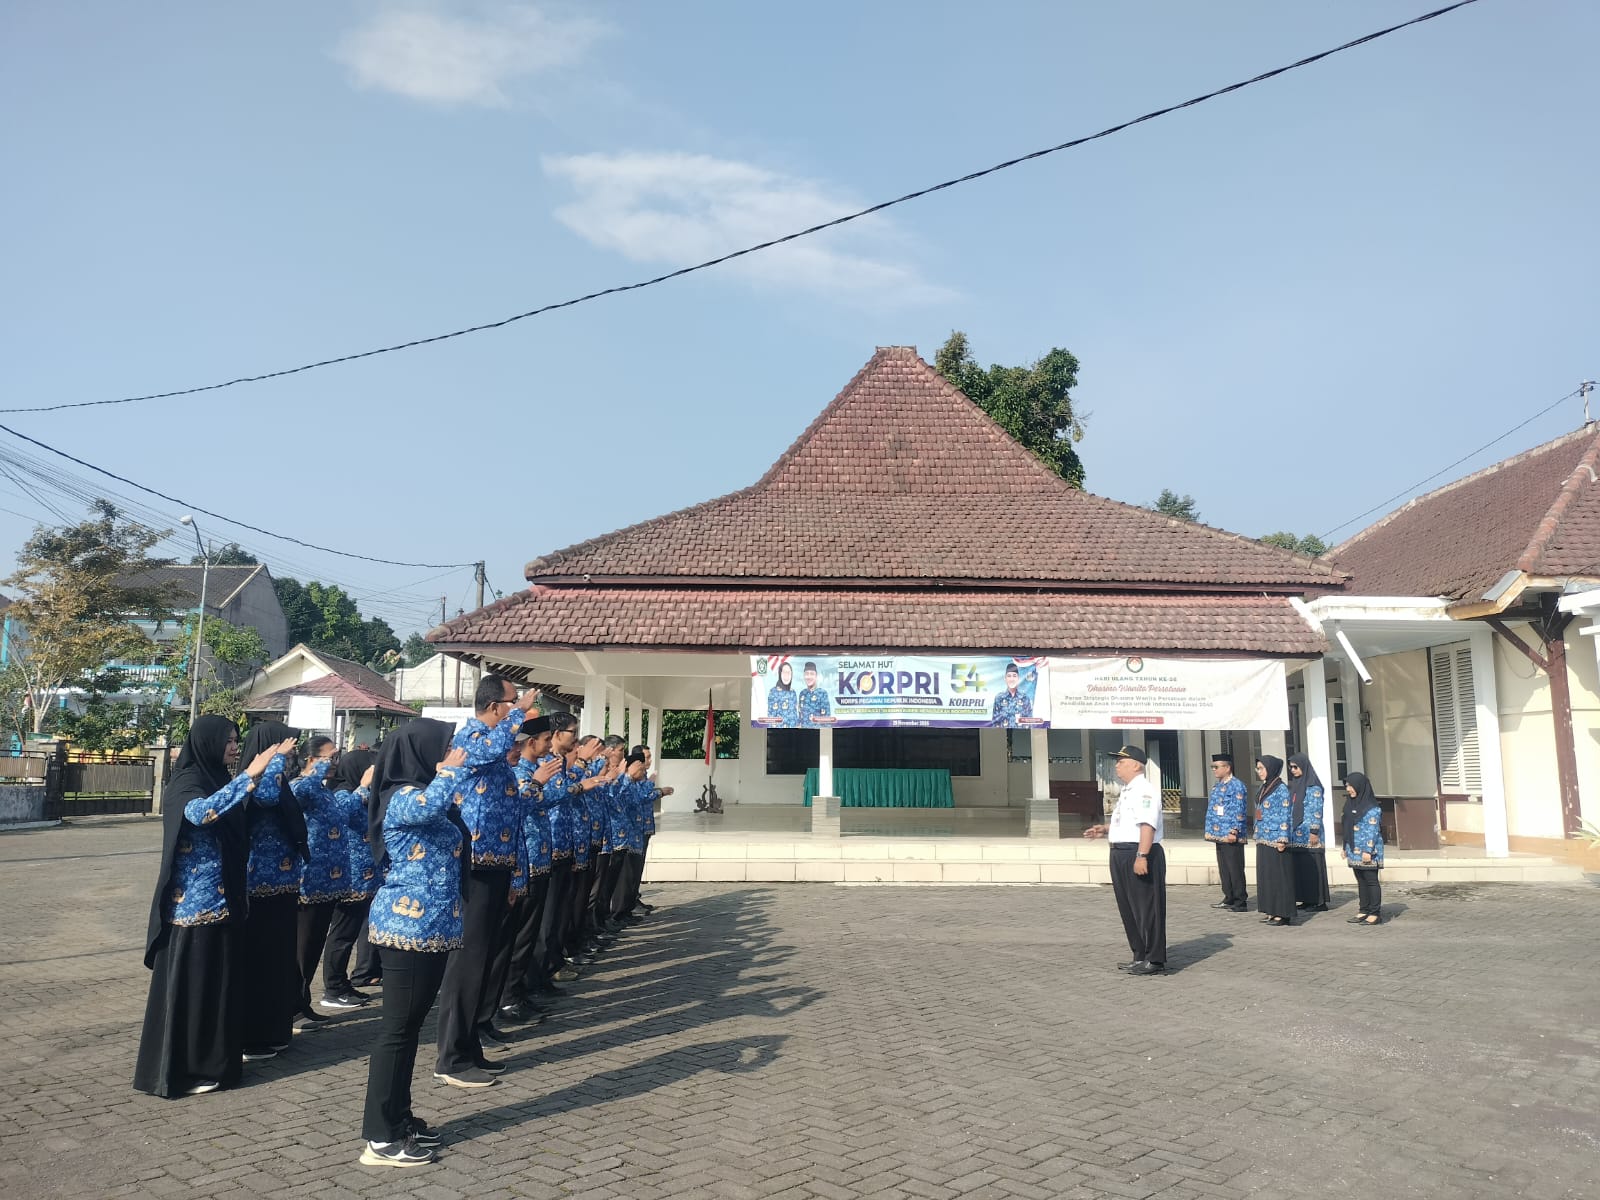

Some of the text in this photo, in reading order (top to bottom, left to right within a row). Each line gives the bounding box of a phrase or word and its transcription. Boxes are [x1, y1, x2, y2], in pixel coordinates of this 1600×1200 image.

[838, 660, 894, 669] SELAMAT HUT
[838, 671, 940, 695] KORPRI
[840, 697, 859, 705] KORPS
[908, 697, 938, 705] INDONESIA
[948, 697, 985, 707] KORPRI
